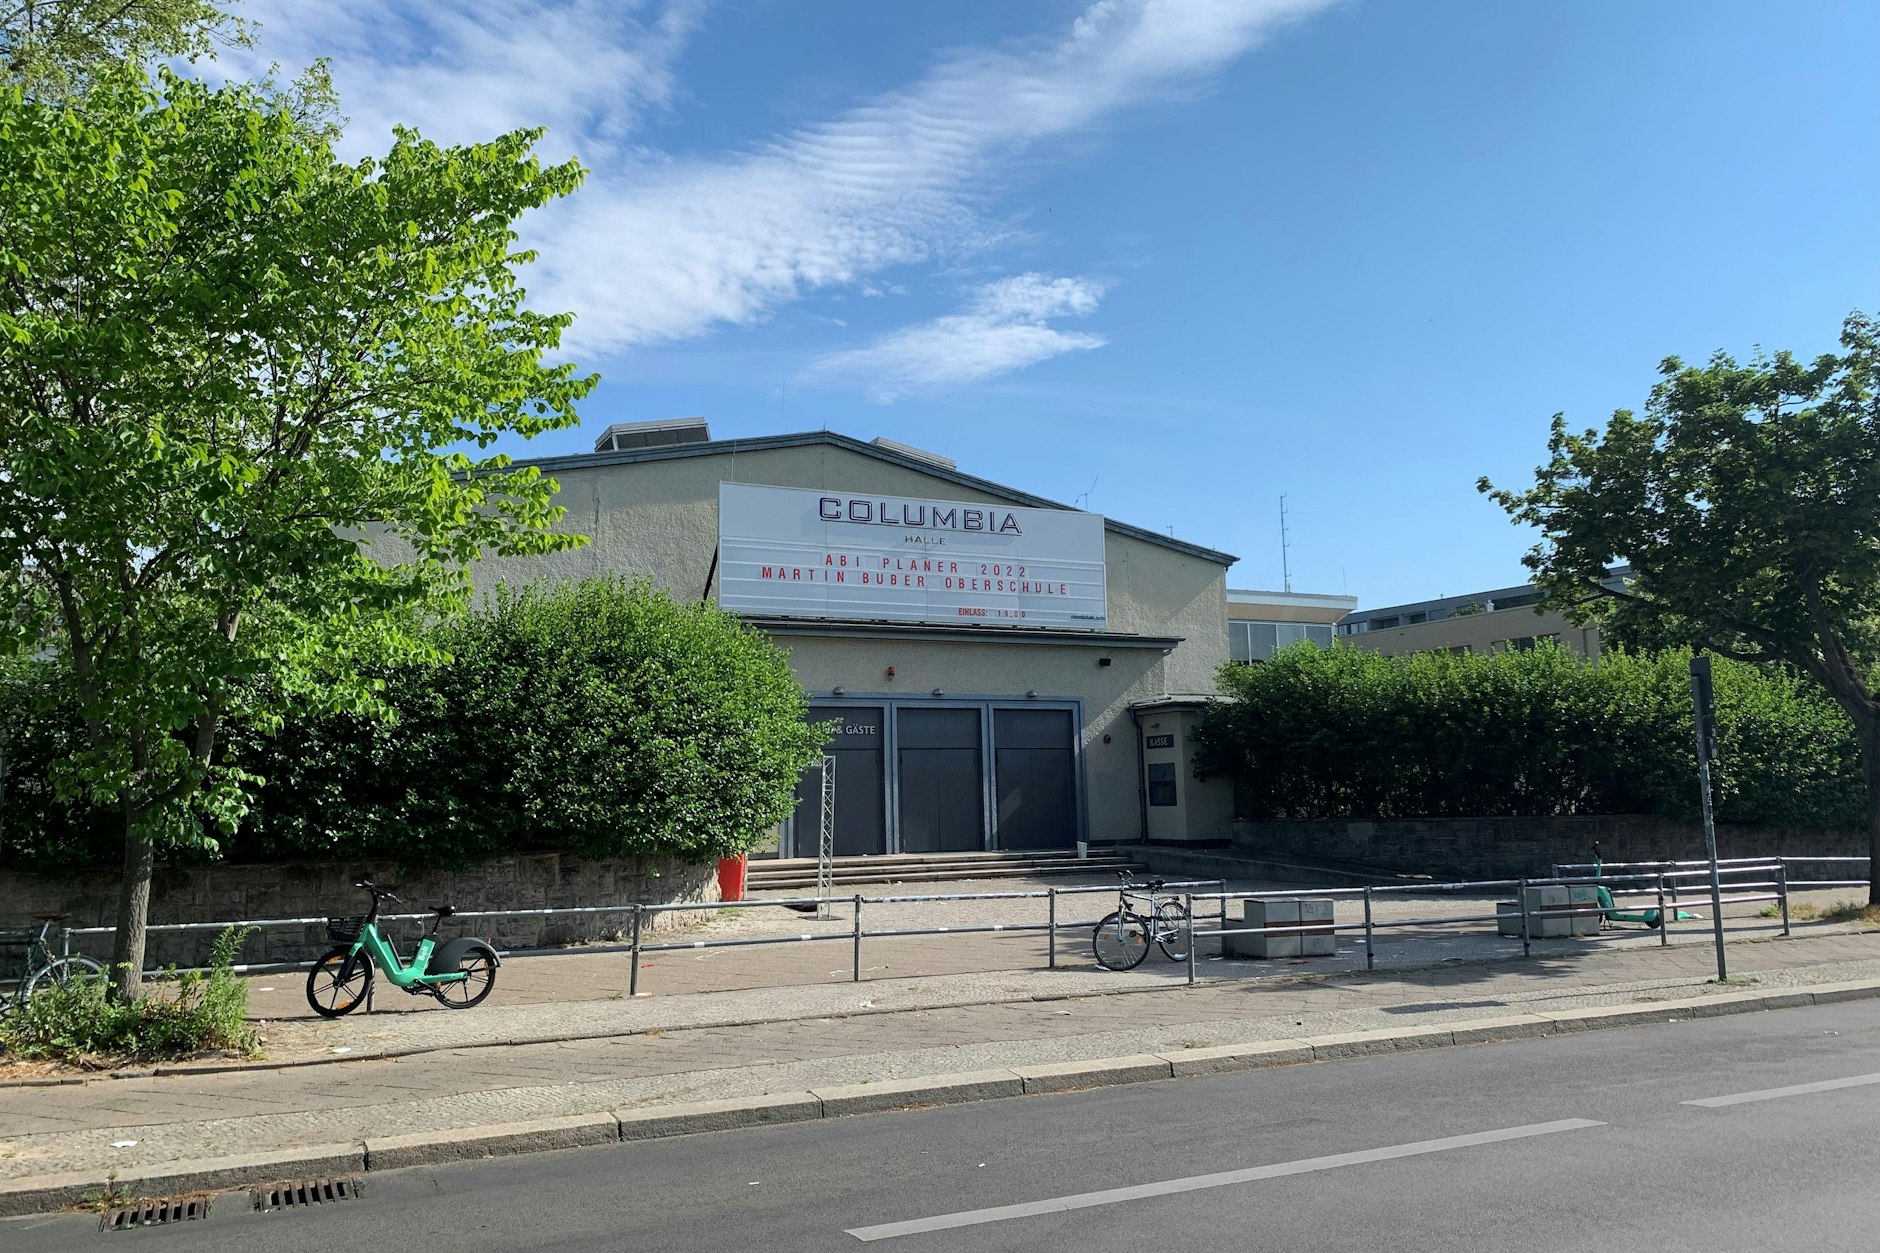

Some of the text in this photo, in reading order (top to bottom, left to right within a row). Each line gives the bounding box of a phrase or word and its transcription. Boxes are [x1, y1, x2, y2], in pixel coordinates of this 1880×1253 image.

[819, 497, 1022, 534] COLUMBIA
[905, 535, 946, 545] HALLE
[825, 554, 1025, 577] ABI PLANER 2022
[762, 566, 1066, 594] MARTIN BUBER OBERSCHULE
[958, 608, 988, 616] EINLASS:
[845, 723, 876, 735] GÄSTE
[1150, 737, 1168, 746] KASSE
[417, 945, 429, 961] Bolt
